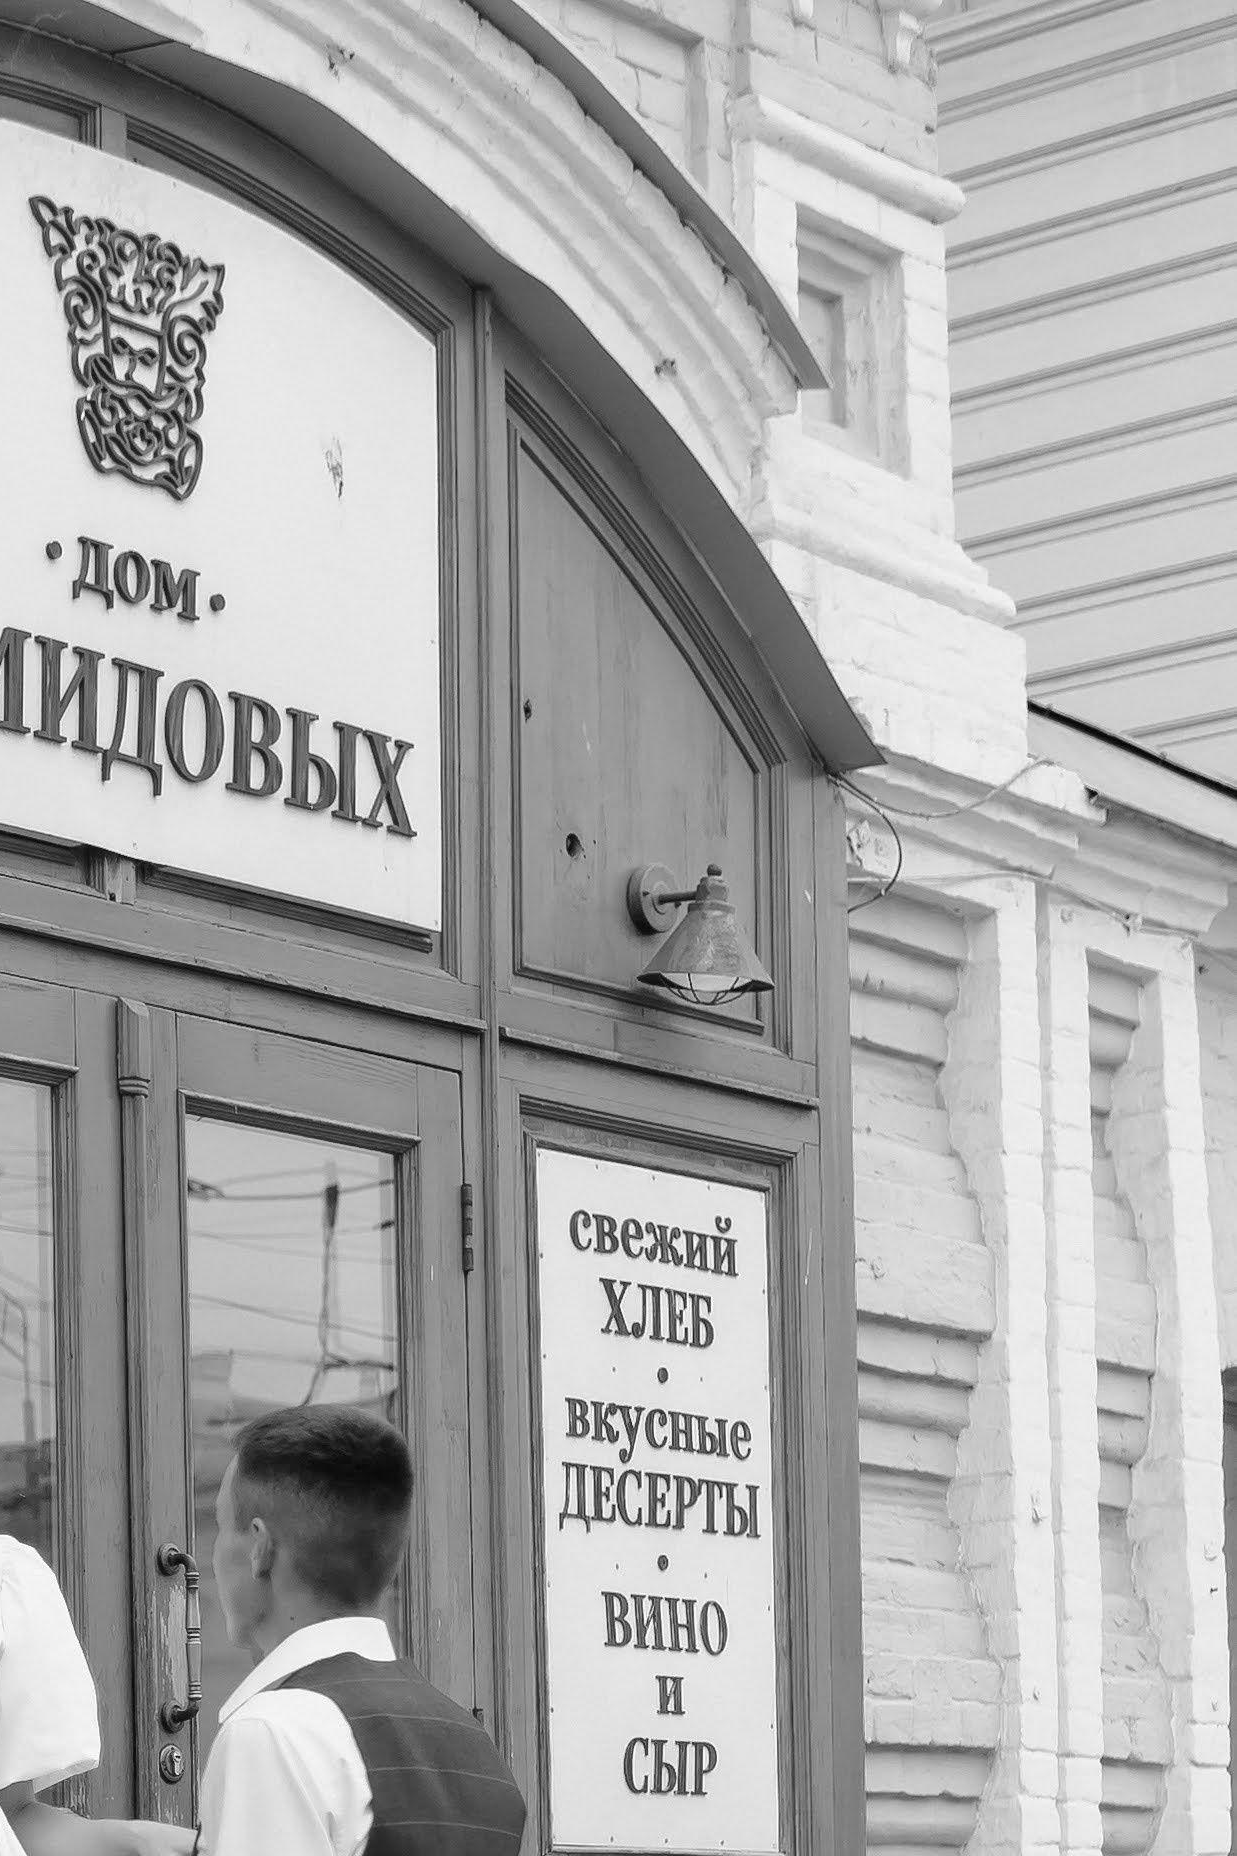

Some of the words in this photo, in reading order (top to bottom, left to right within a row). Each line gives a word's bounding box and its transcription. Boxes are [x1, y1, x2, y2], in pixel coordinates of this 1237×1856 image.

[569, 1209, 739, 1278] свежий
[599, 1277, 715, 1349] ХЛЕБ
[564, 1396, 752, 1464] вкусные
[558, 1461, 761, 1539] ДЕСЕРТЫ
[600, 1591, 729, 1656] ВИНО
[623, 1737, 718, 1797] СЫР
